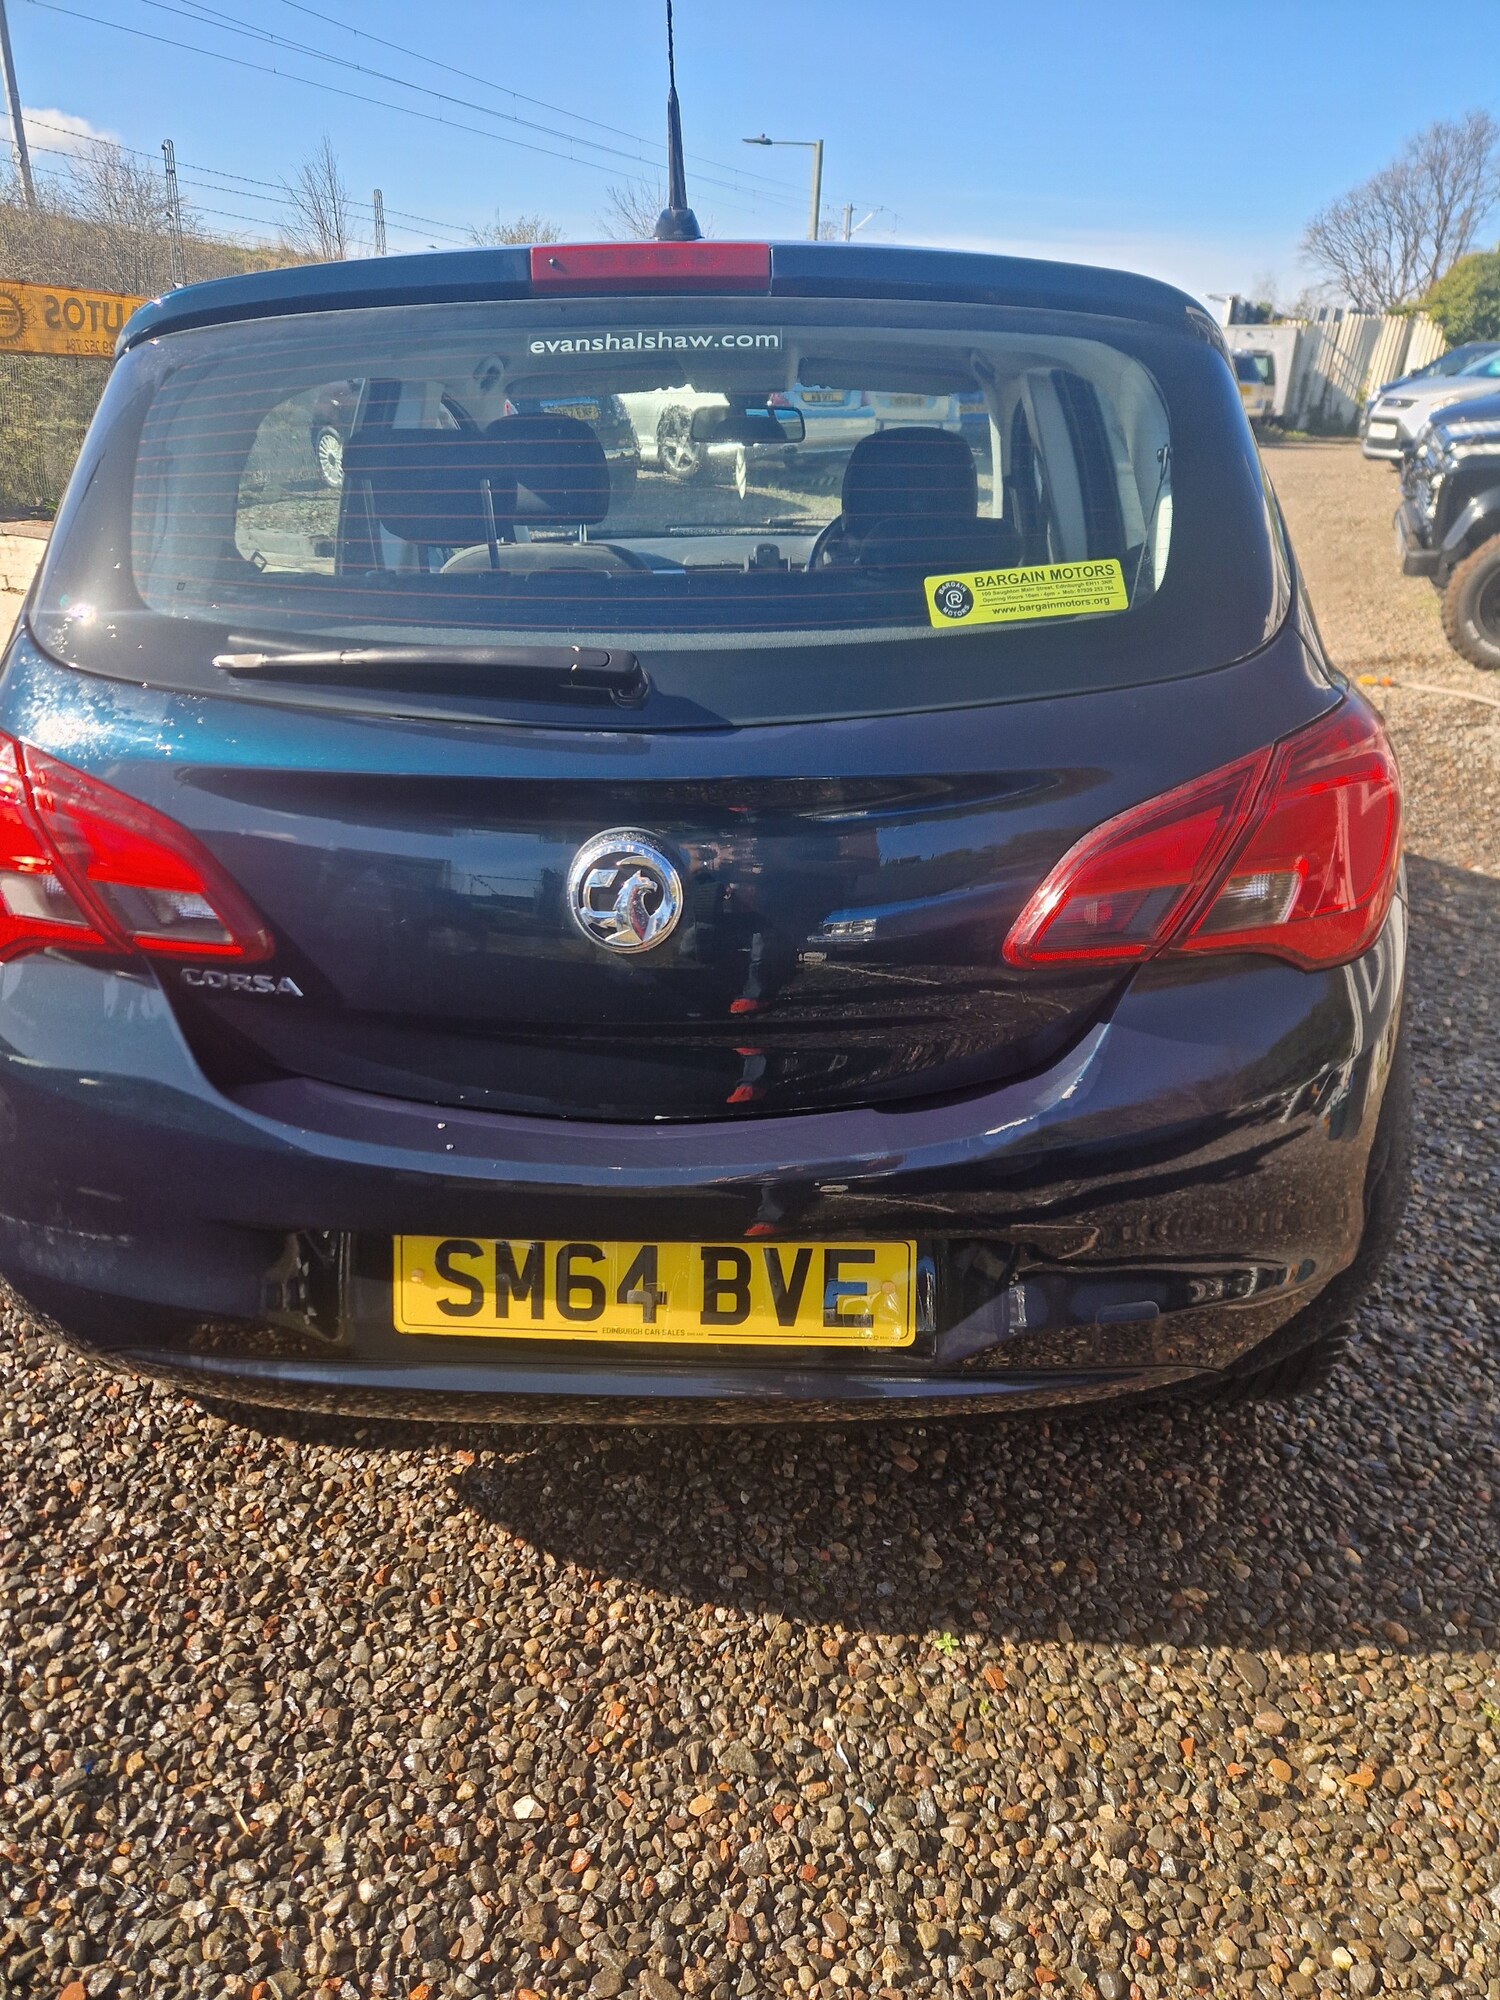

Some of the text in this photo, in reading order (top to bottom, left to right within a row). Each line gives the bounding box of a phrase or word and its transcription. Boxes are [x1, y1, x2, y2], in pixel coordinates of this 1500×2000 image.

[530, 331, 779, 354] evanshalshaw.com
[974, 564, 1115, 588] BARGAIN MOTORS
[938, 581, 968, 595] BARGAIN
[942, 605, 970, 617] MOTORS
[992, 597, 1110, 615] www.bargainmotors.org
[181, 968, 304, 997] CORSA
[435, 1239, 876, 1329] SM64 BVE
[602, 1327, 642, 1335] EDINBURGH
[644, 1328, 660, 1336] CAR
[662, 1328, 685, 1337] SALES
